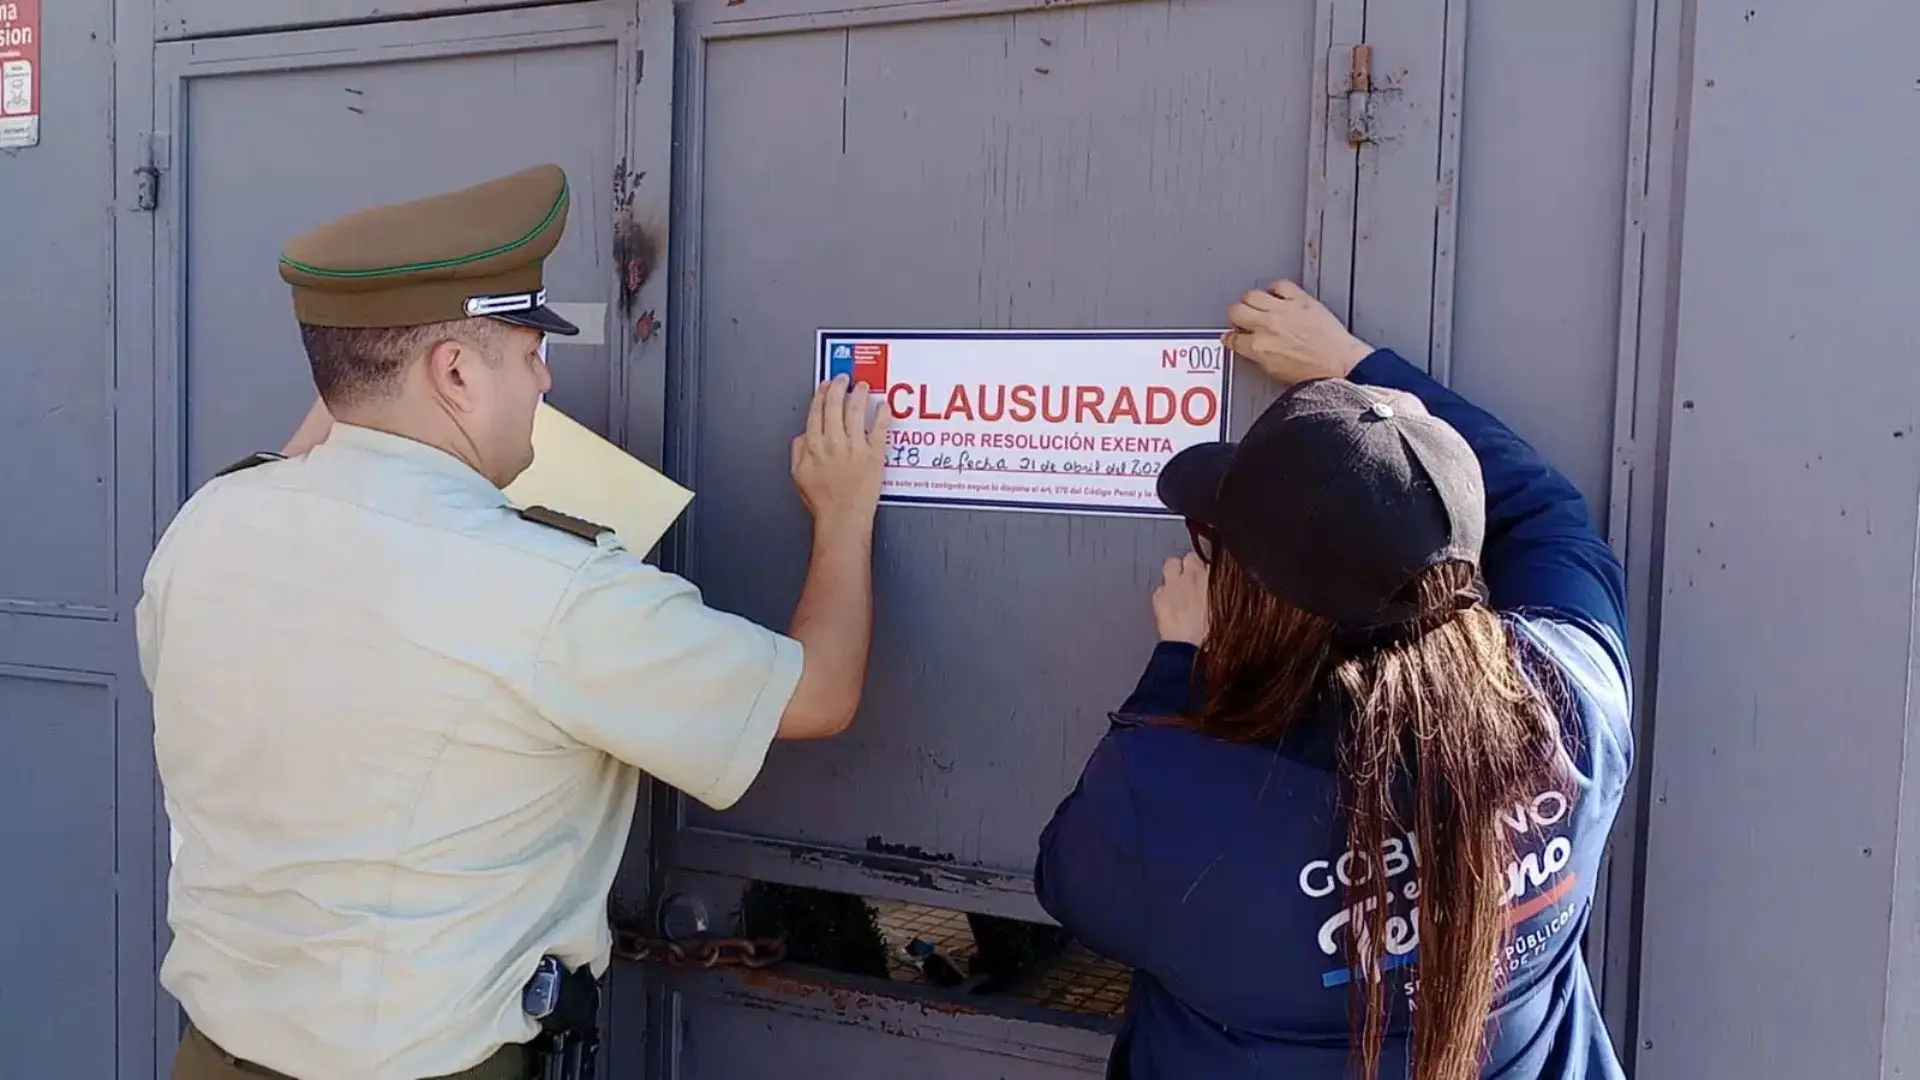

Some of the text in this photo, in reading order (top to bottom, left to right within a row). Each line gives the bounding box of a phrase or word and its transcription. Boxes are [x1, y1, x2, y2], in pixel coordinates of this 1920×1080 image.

[887, 382, 1217, 425] CLAUSURADO
[941, 431, 976, 448] POR
[980, 432, 1095, 451] RESOLUCIÓN
[1101, 436, 1173, 453] EXENTA
[884, 445, 921, 467] 78
[931, 452, 953, 469] de
[1083, 486, 1112, 497] Código
[1113, 488, 1136, 496] Penal
[1299, 790, 1567, 898] GOBINO
